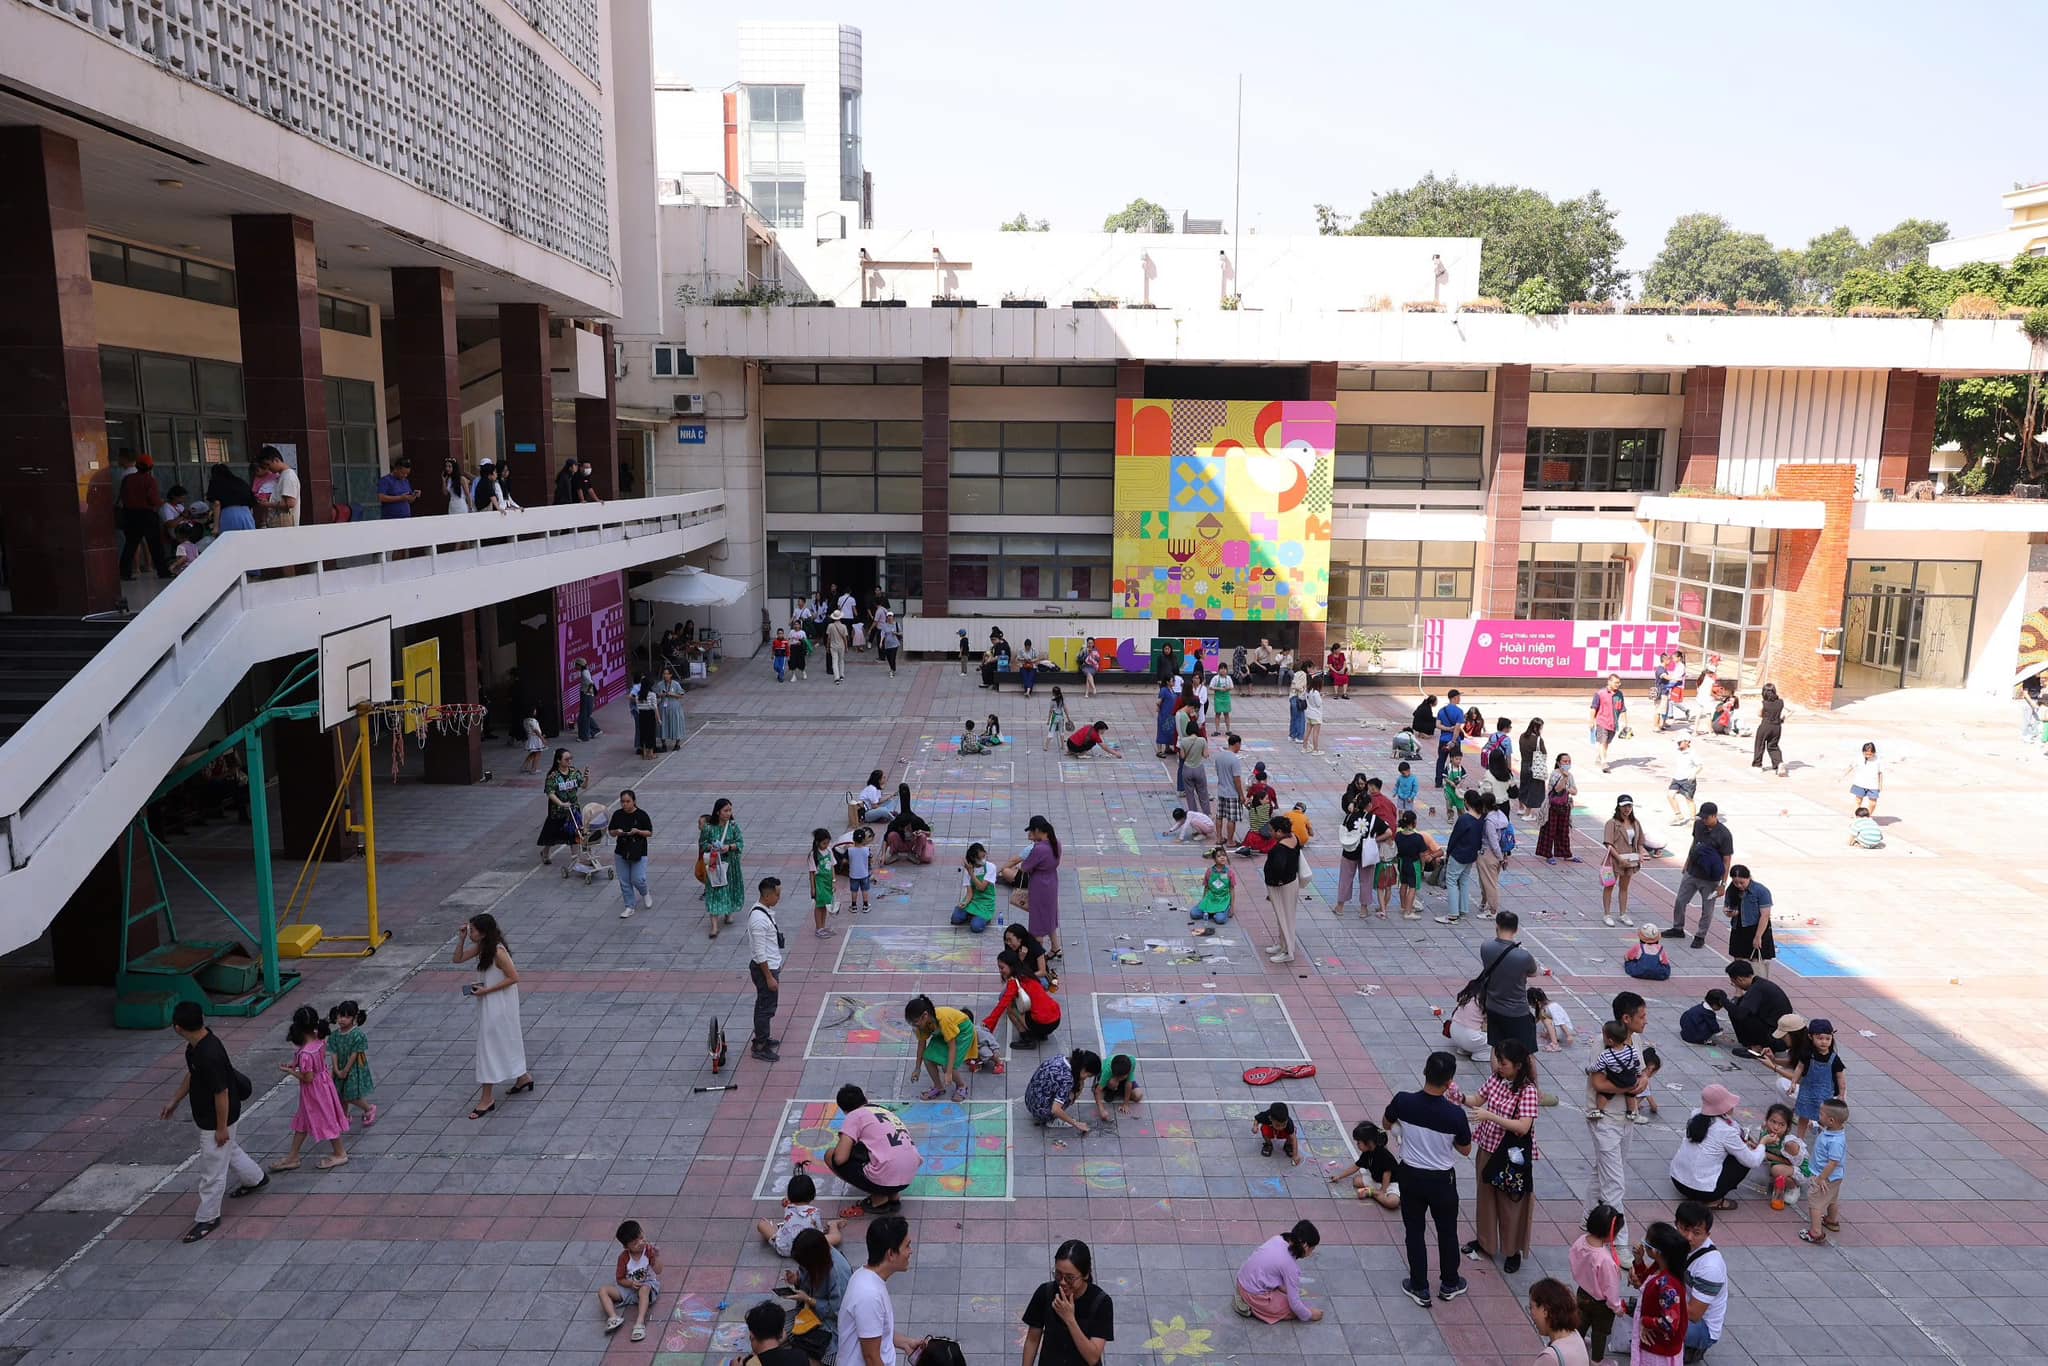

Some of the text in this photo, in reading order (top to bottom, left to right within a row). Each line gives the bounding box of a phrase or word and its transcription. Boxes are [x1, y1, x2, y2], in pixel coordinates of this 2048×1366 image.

[680, 429, 704, 439] NHÀ C
[1500, 642, 1556, 654] Hoài niệm
[1499, 655, 1570, 668] cho tương lai
